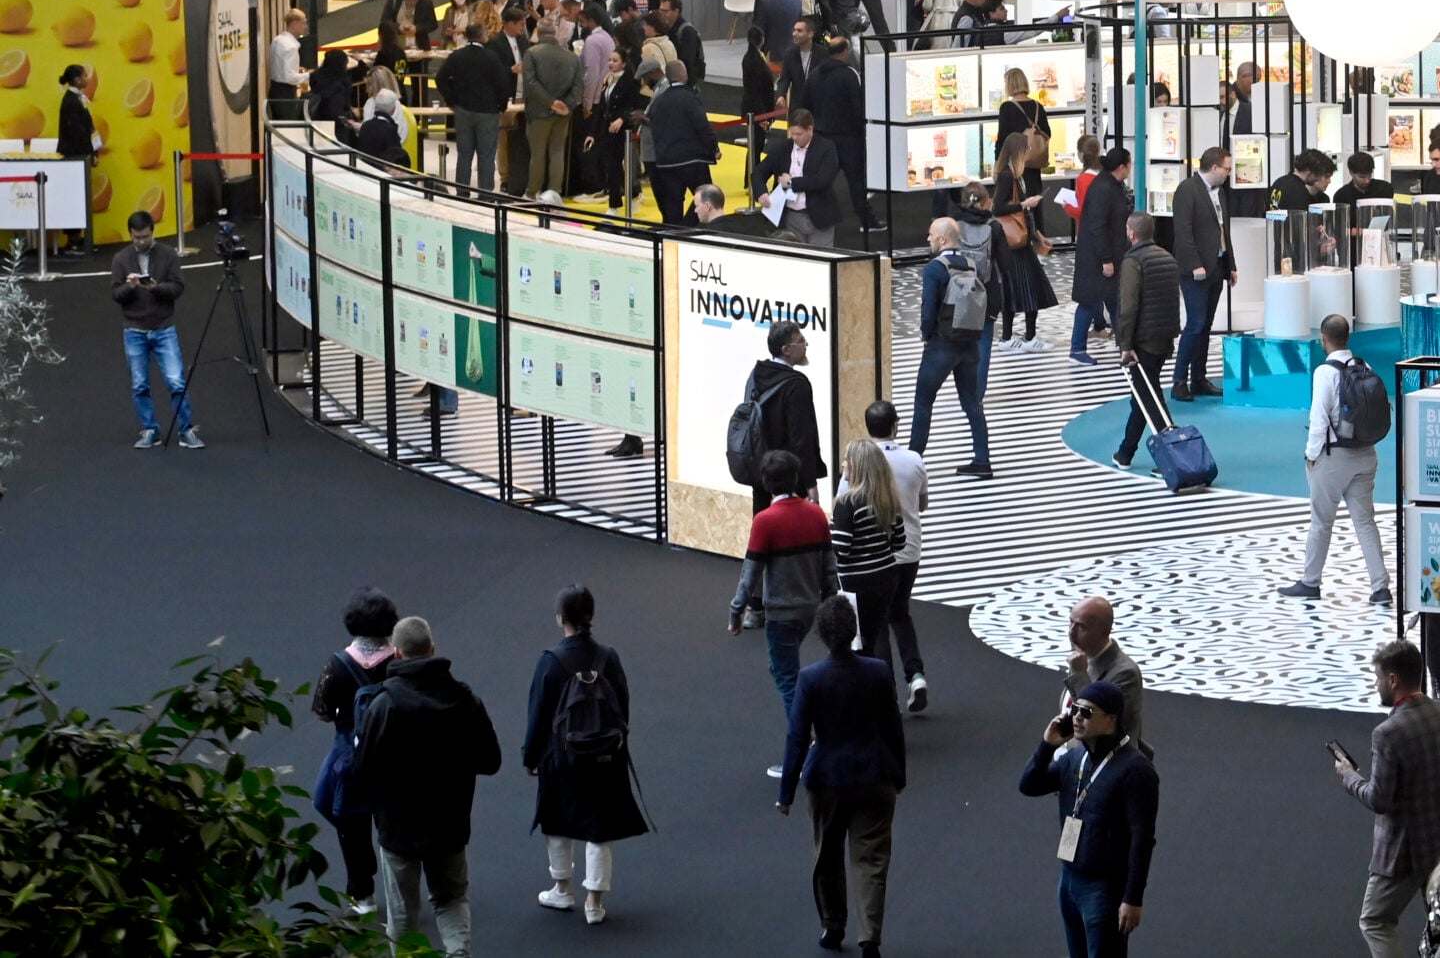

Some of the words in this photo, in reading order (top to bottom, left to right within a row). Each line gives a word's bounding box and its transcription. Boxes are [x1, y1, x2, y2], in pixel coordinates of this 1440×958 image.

[218, 28, 243, 55] TASTE
[689, 259, 728, 287] SIAL
[690, 288, 827, 333] INNOVATION
[1426, 449, 1439, 458] DE
